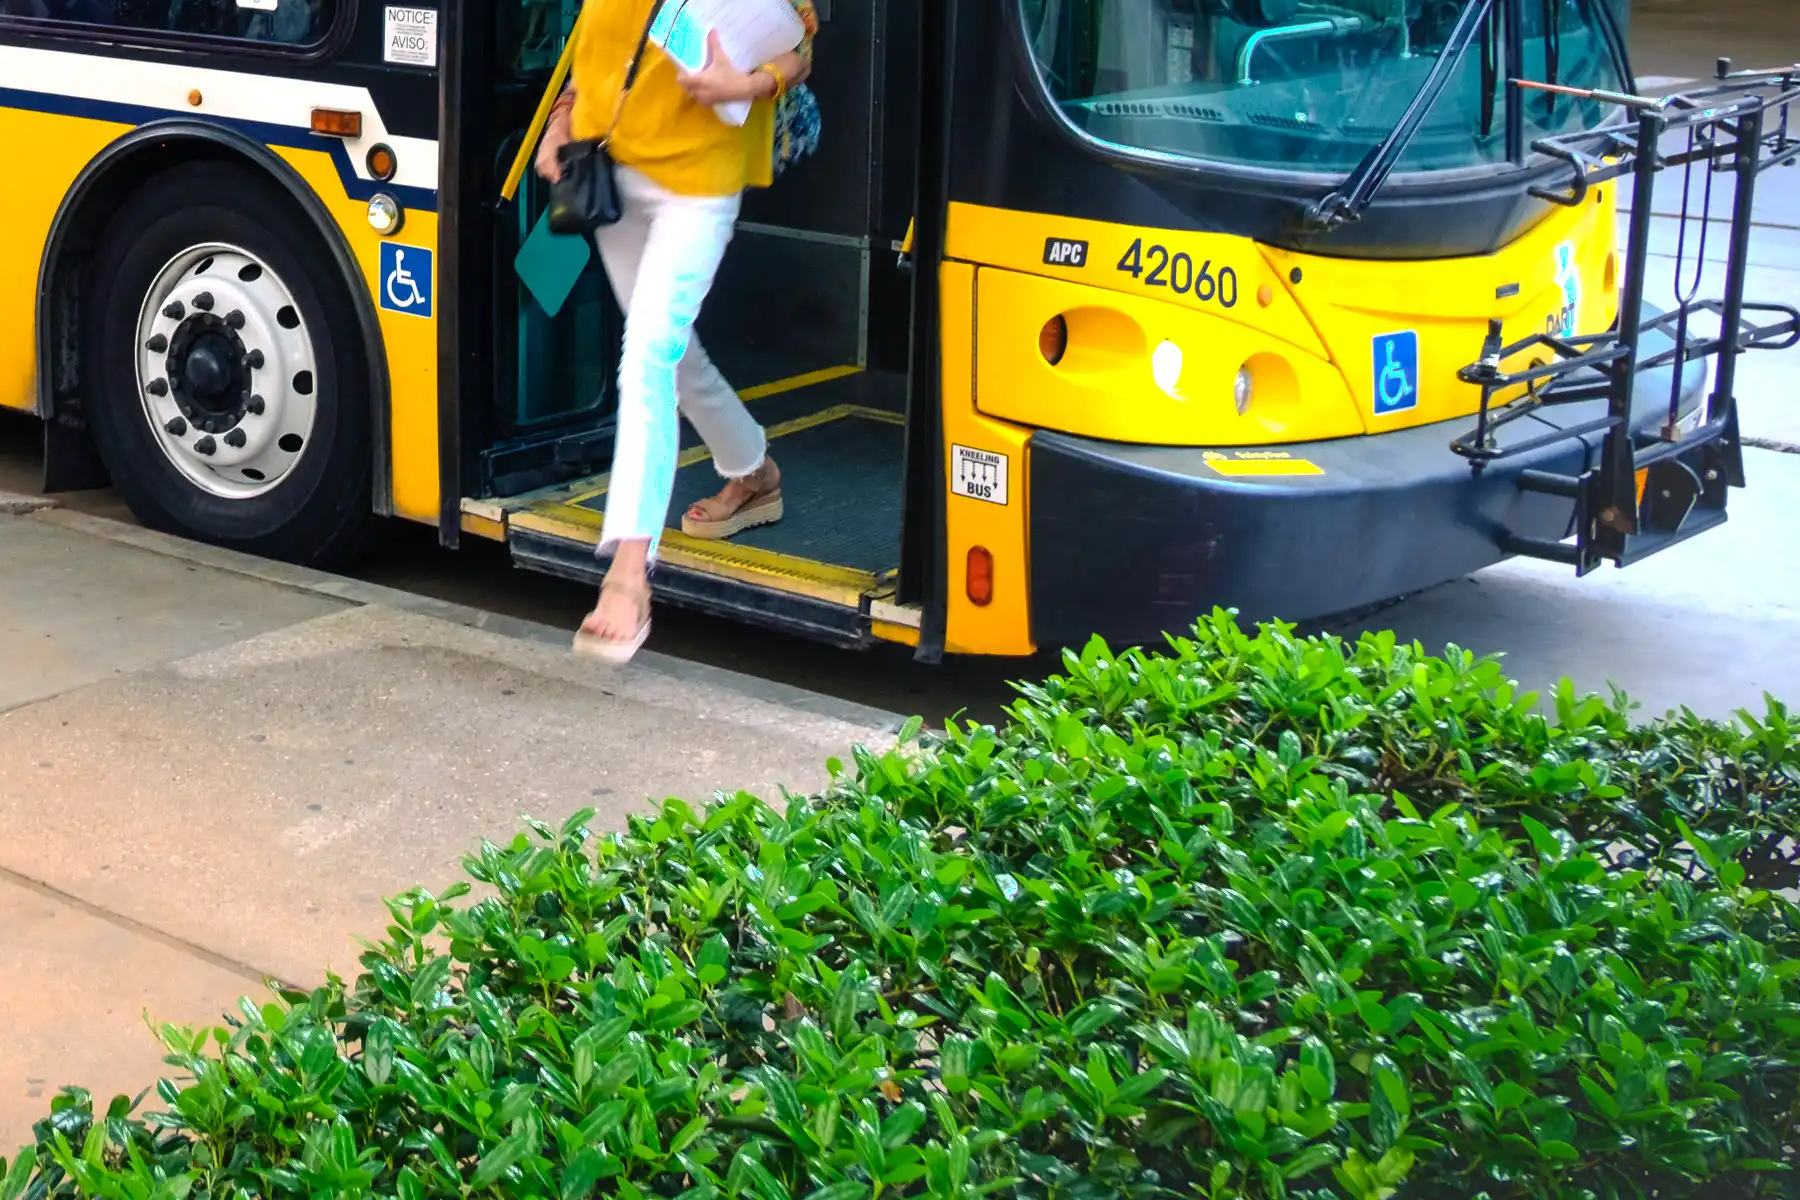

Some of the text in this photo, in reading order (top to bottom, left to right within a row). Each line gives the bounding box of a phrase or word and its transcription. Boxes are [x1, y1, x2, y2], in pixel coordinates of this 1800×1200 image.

[1049, 242, 1082, 264] APC
[1117, 237, 1238, 309] 42060
[959, 448, 1000, 465] KNEELING
[967, 481, 992, 498] BUS
